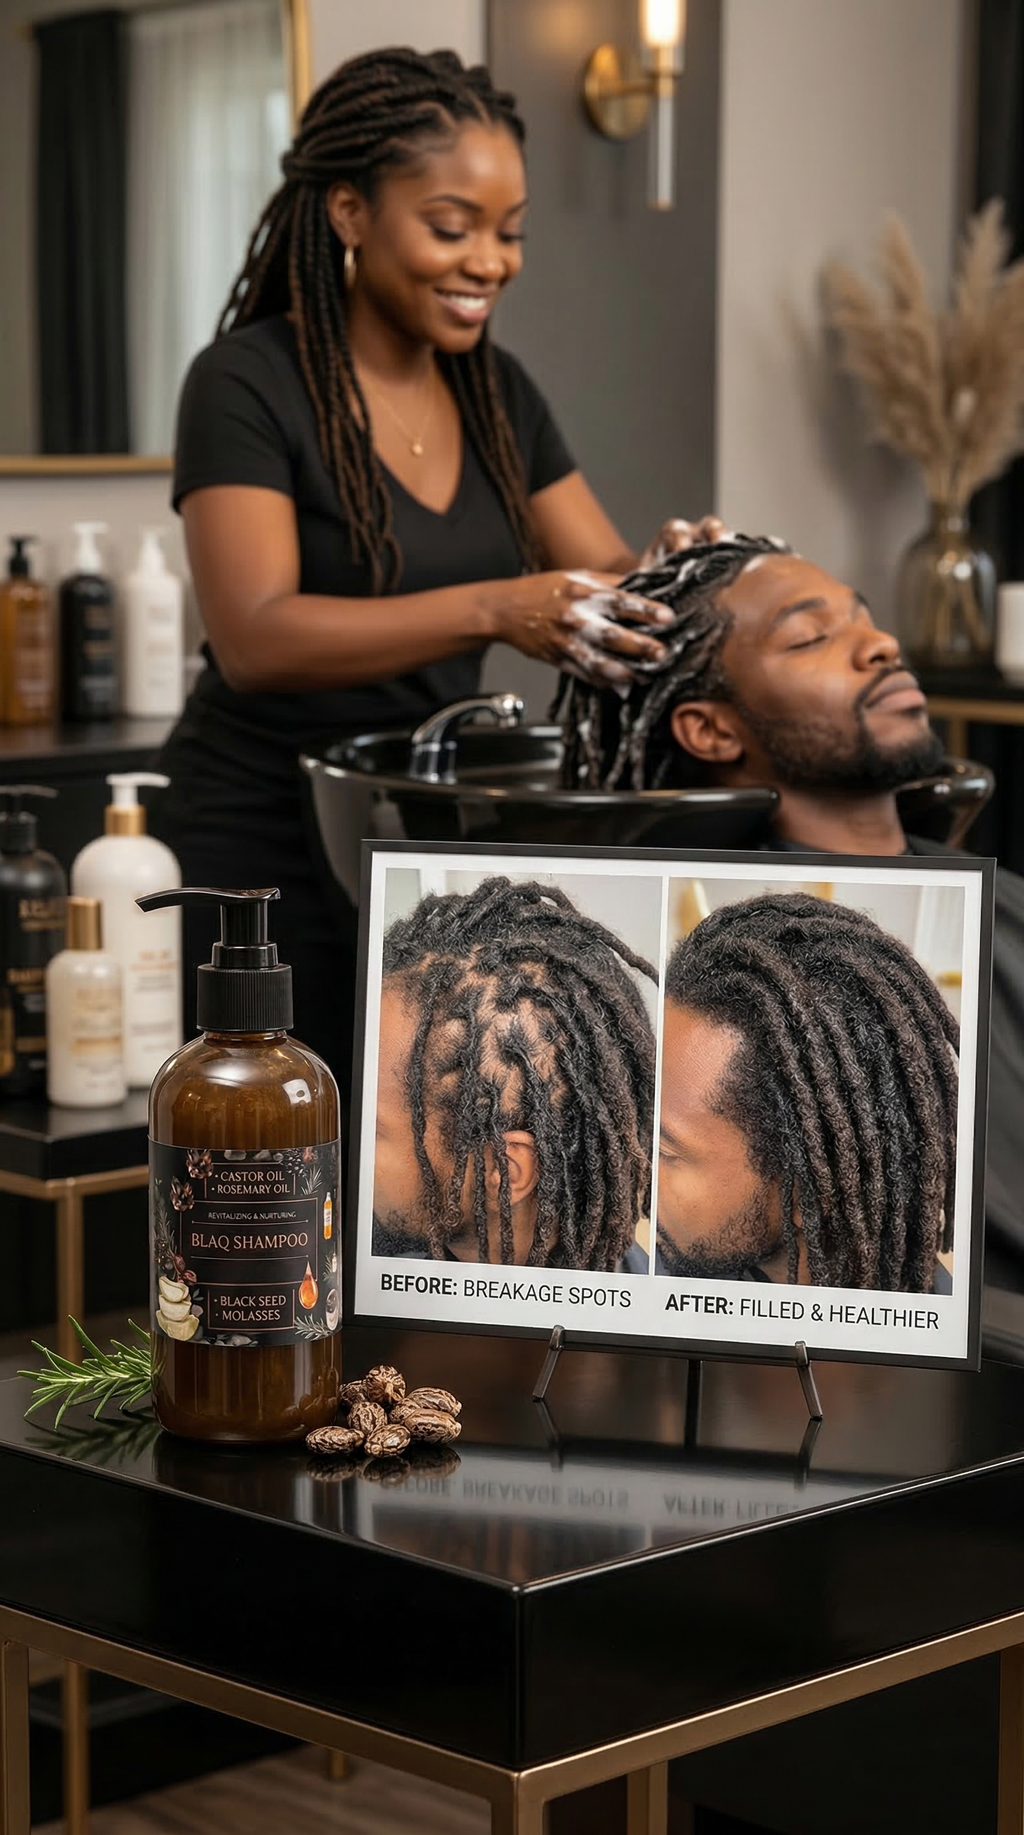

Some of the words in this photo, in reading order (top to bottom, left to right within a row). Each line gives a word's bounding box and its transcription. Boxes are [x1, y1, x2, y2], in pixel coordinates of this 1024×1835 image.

[220, 1171, 264, 1182] CASTOR
[266, 1170, 285, 1182] OIL
[217, 1184, 271, 1195] ROSEMARY
[273, 1183, 291, 1194] OIL
[208, 1211, 252, 1220] REVITALIZING
[259, 1211, 297, 1220] NURTURING
[191, 1232, 230, 1252] BLAQ
[233, 1232, 308, 1249] SHAMPOO
[380, 1273, 459, 1297] BEFORE:
[463, 1279, 564, 1303] BREAKAGE
[568, 1286, 632, 1308] SPOTS
[220, 1295, 256, 1307] BLACK
[258, 1295, 287, 1307] SEED
[222, 1309, 281, 1321] MOLASSES
[665, 1294, 735, 1316] AFTER:
[739, 1299, 806, 1321] FILLED
[810, 1302, 824, 1323] &
[829, 1304, 940, 1330] HEALTHIER
